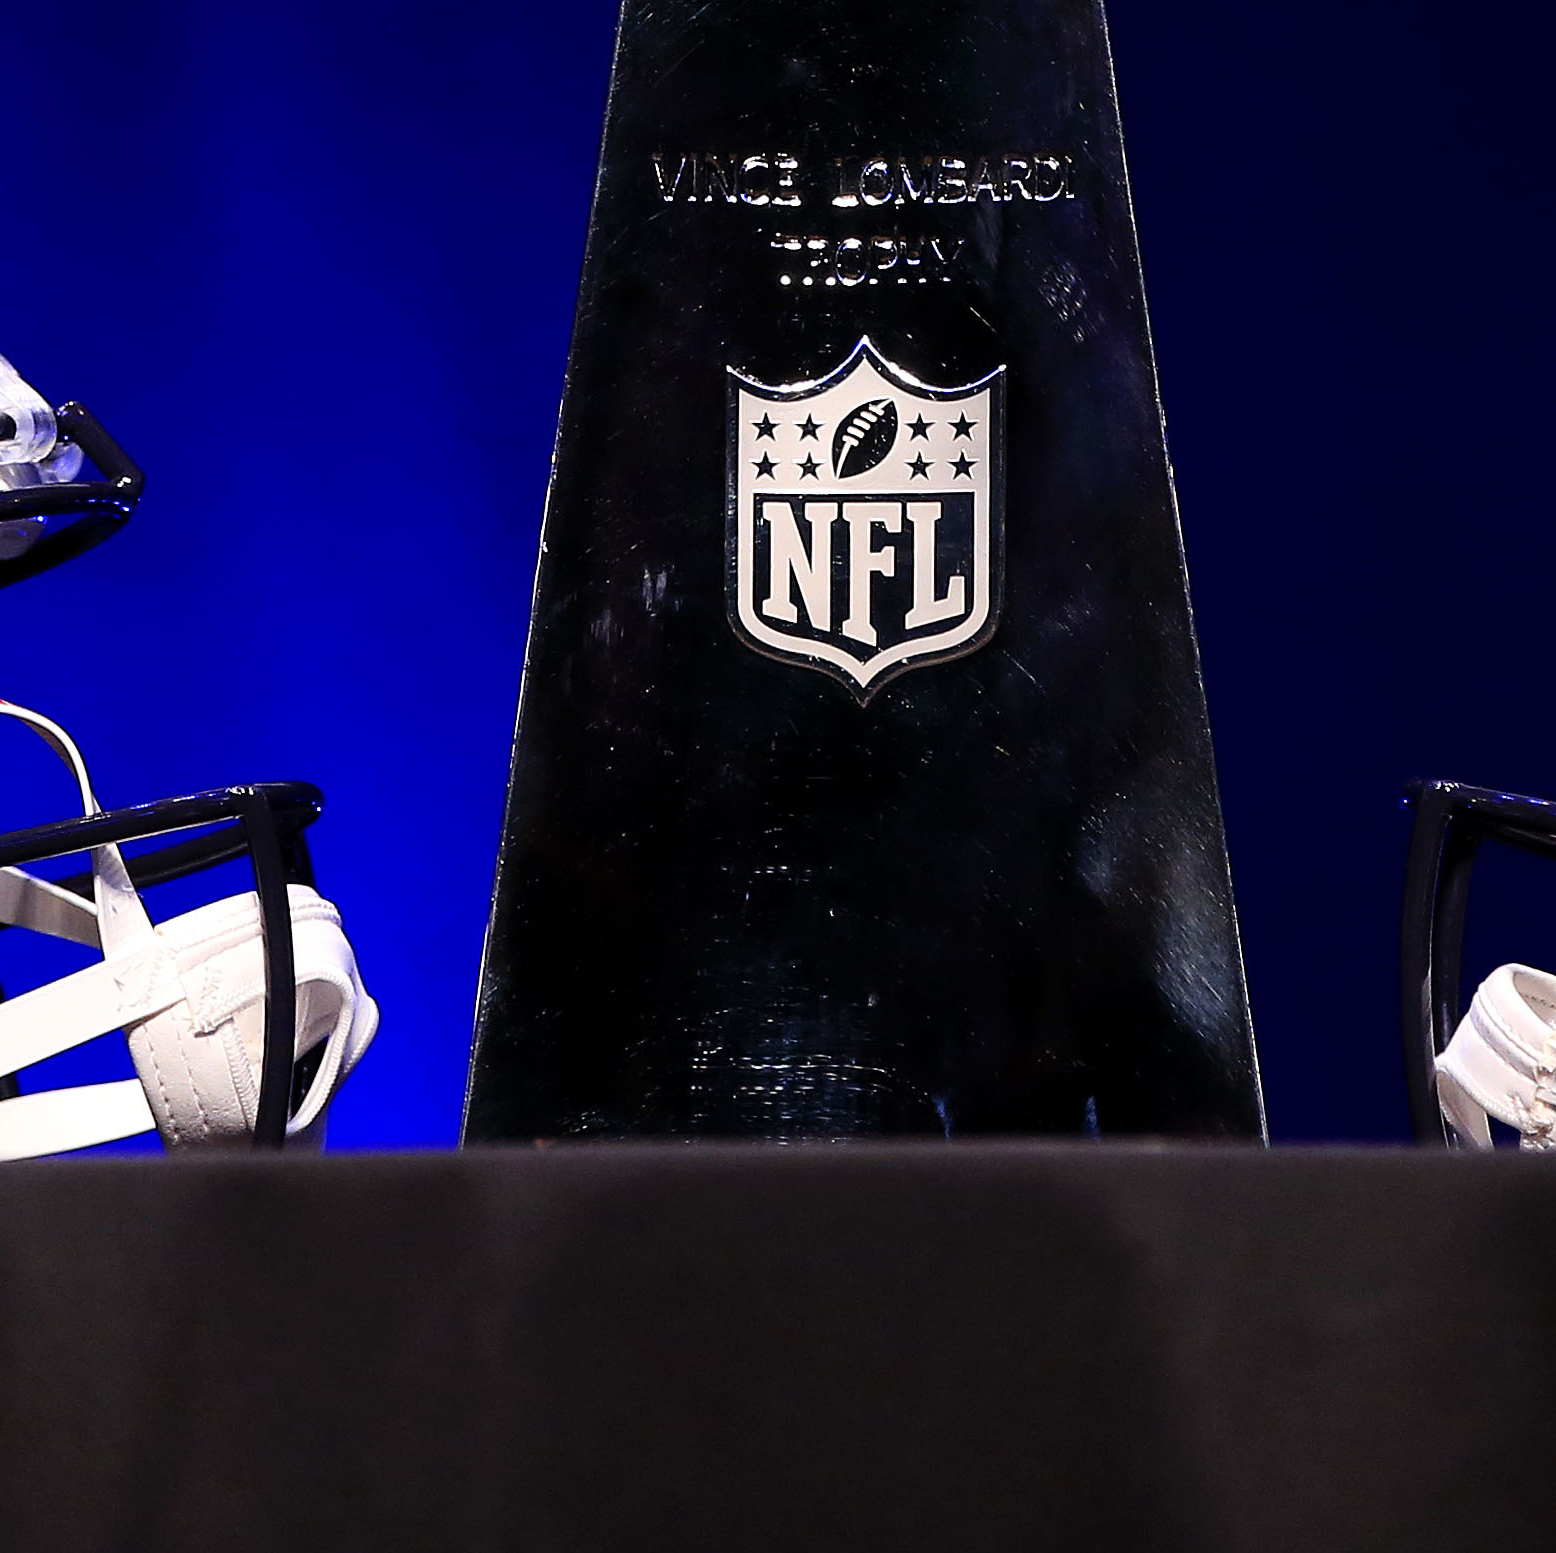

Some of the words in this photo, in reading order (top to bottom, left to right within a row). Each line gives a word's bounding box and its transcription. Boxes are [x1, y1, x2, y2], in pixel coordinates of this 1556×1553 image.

[650, 151, 803, 207] VINCE
[830, 152, 1077, 208] LOMBARDI
[761, 501, 966, 647] NFL
